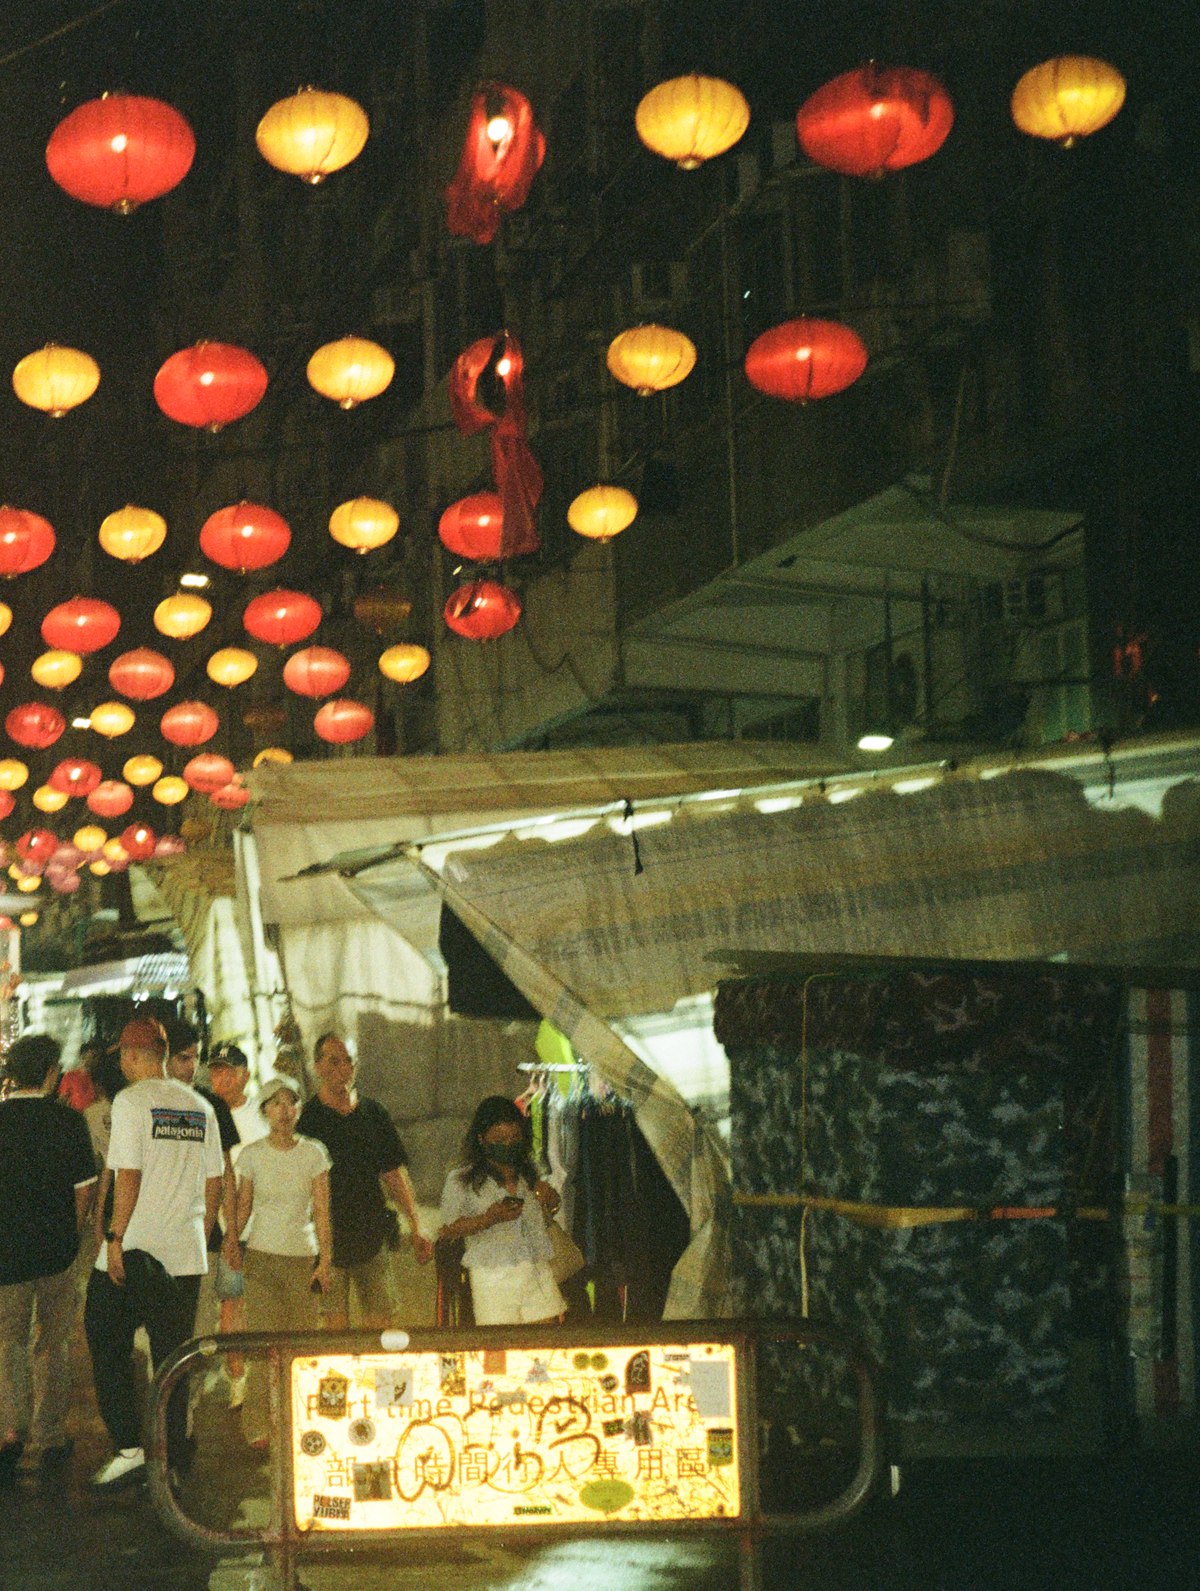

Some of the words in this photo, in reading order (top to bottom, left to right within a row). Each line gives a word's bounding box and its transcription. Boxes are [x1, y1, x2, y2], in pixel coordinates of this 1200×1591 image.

[306, 1393, 371, 1420] Prt
[649, 1386, 701, 1412] Are
[326, 1447, 707, 1489] 部時間行人專用區
